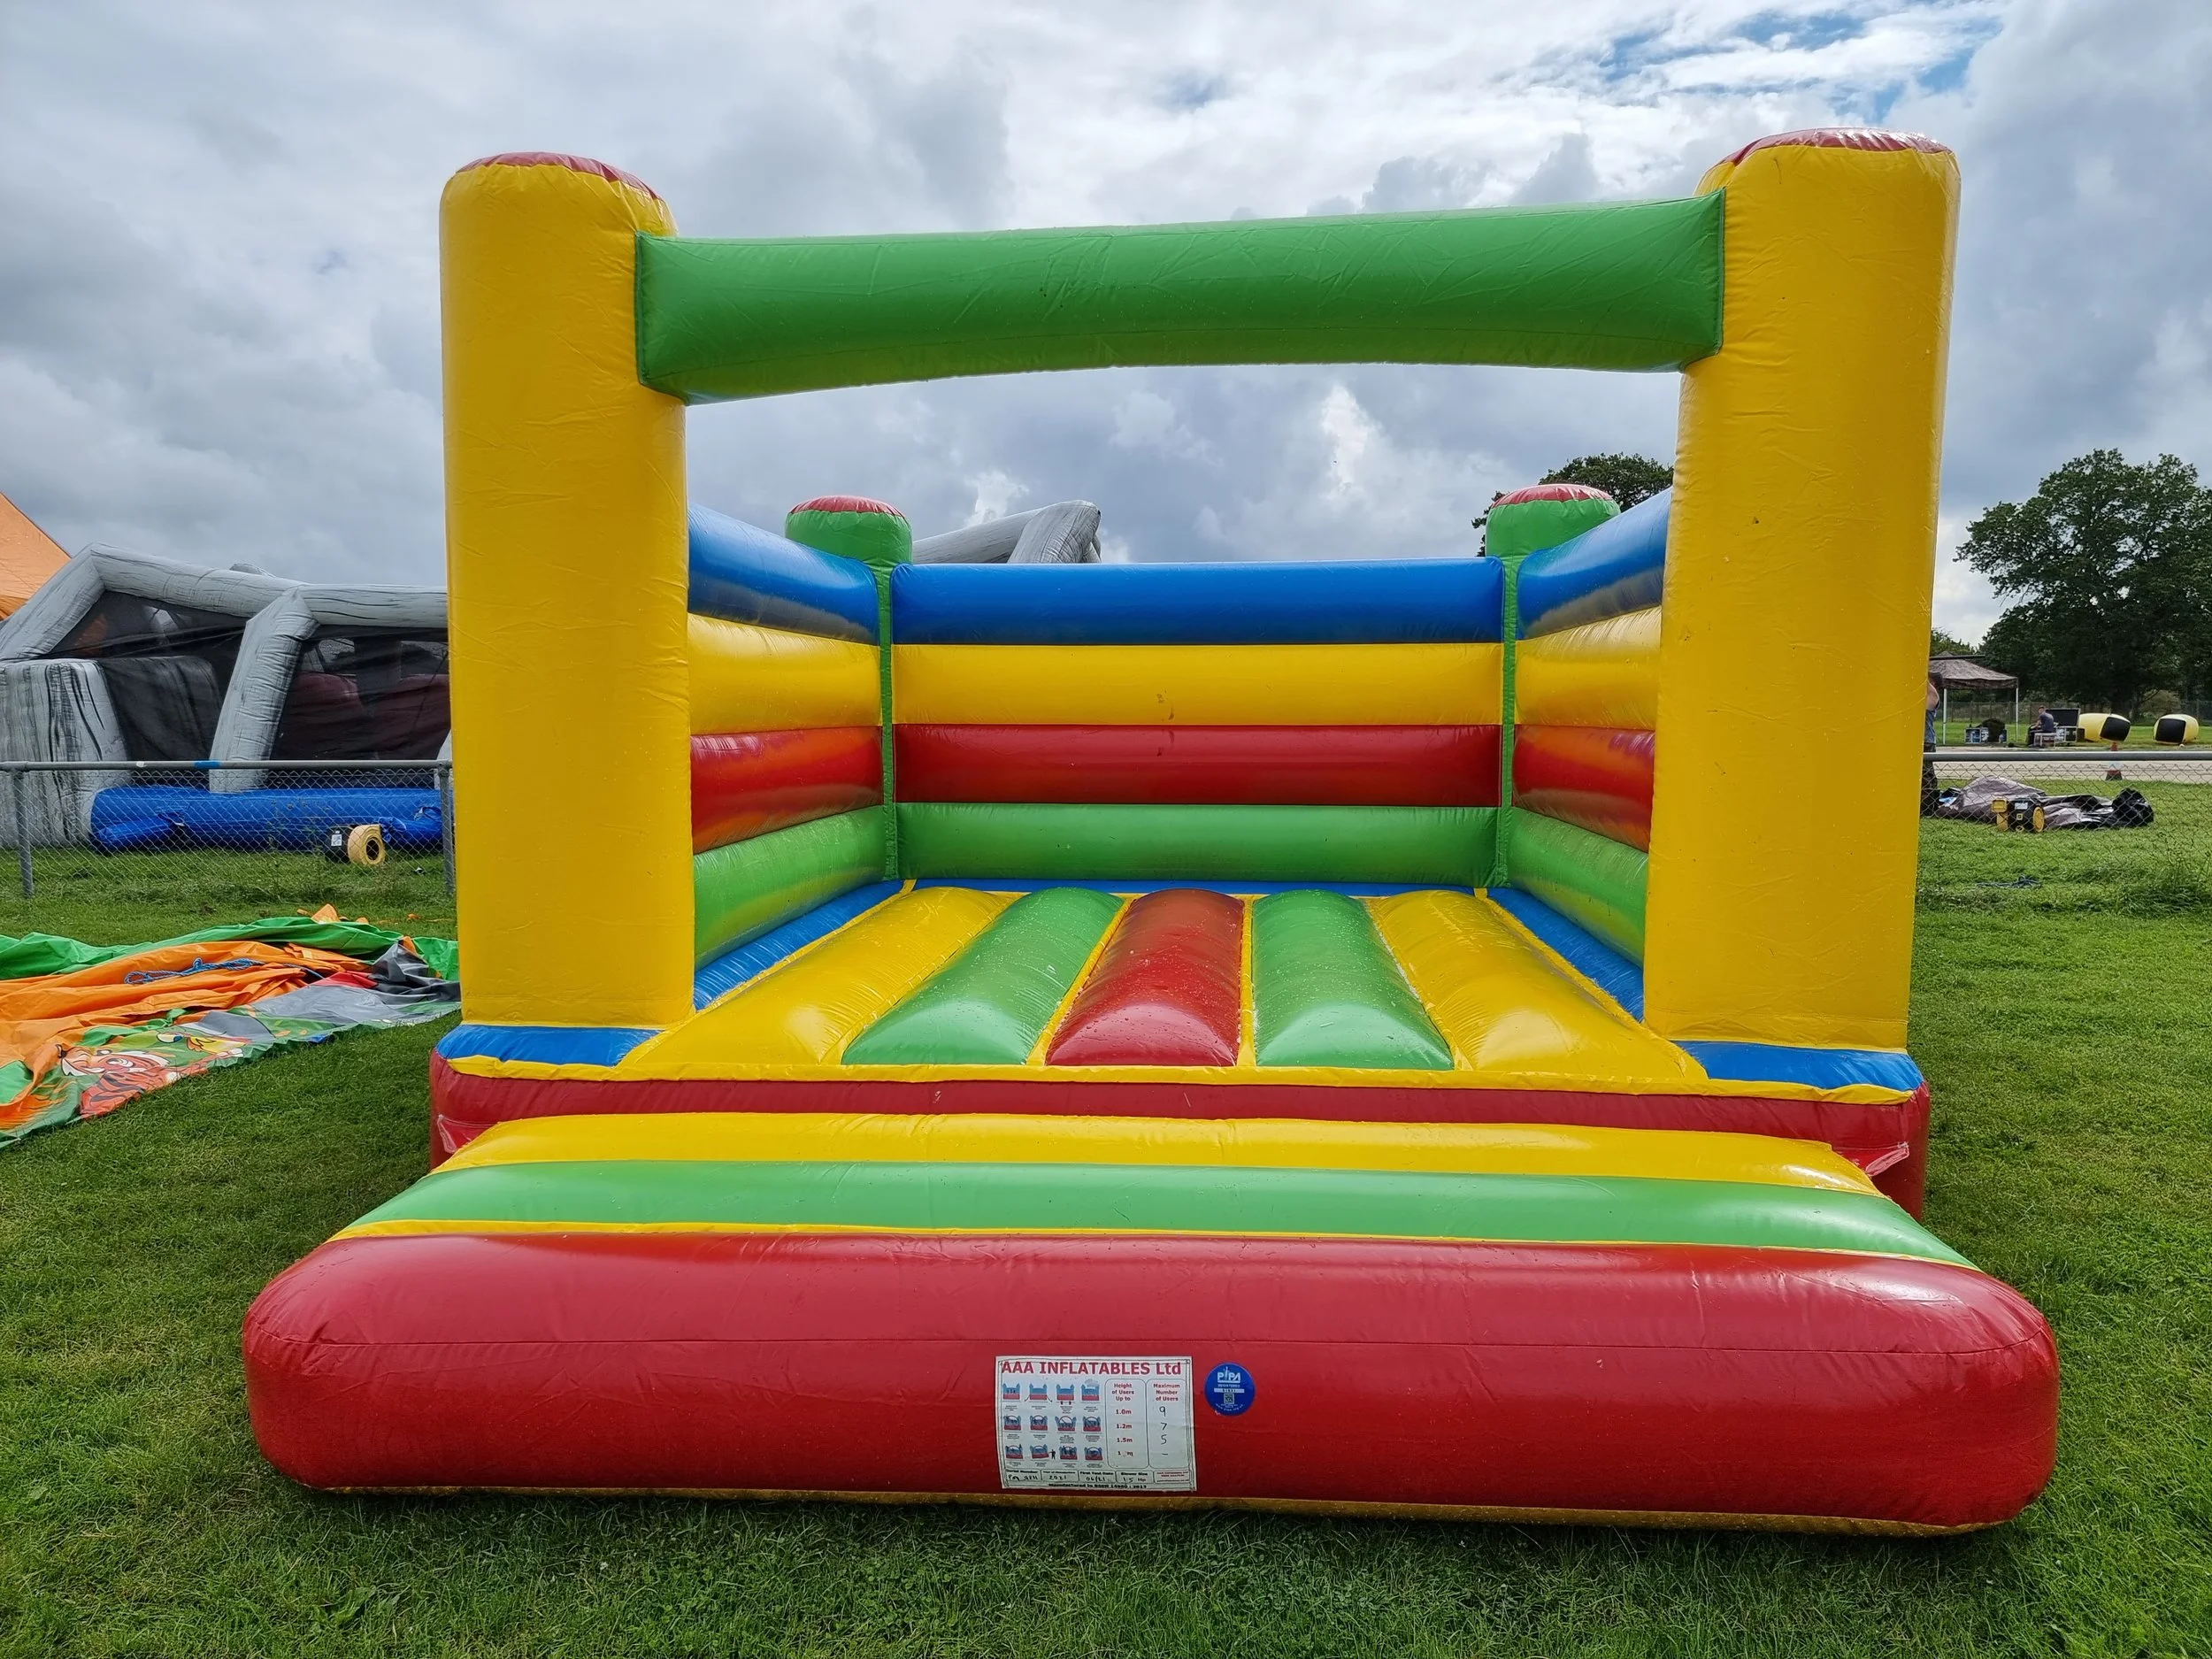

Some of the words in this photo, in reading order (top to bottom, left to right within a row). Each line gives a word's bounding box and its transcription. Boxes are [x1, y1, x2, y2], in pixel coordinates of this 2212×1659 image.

[1002, 1361, 1033, 1374] AAA
[1040, 1362, 1150, 1375] INFLATABLES
[1156, 1362, 1181, 1375] Ltd
[1159, 1406, 1166, 1417] 9
[1160, 1422, 1167, 1431] 7
